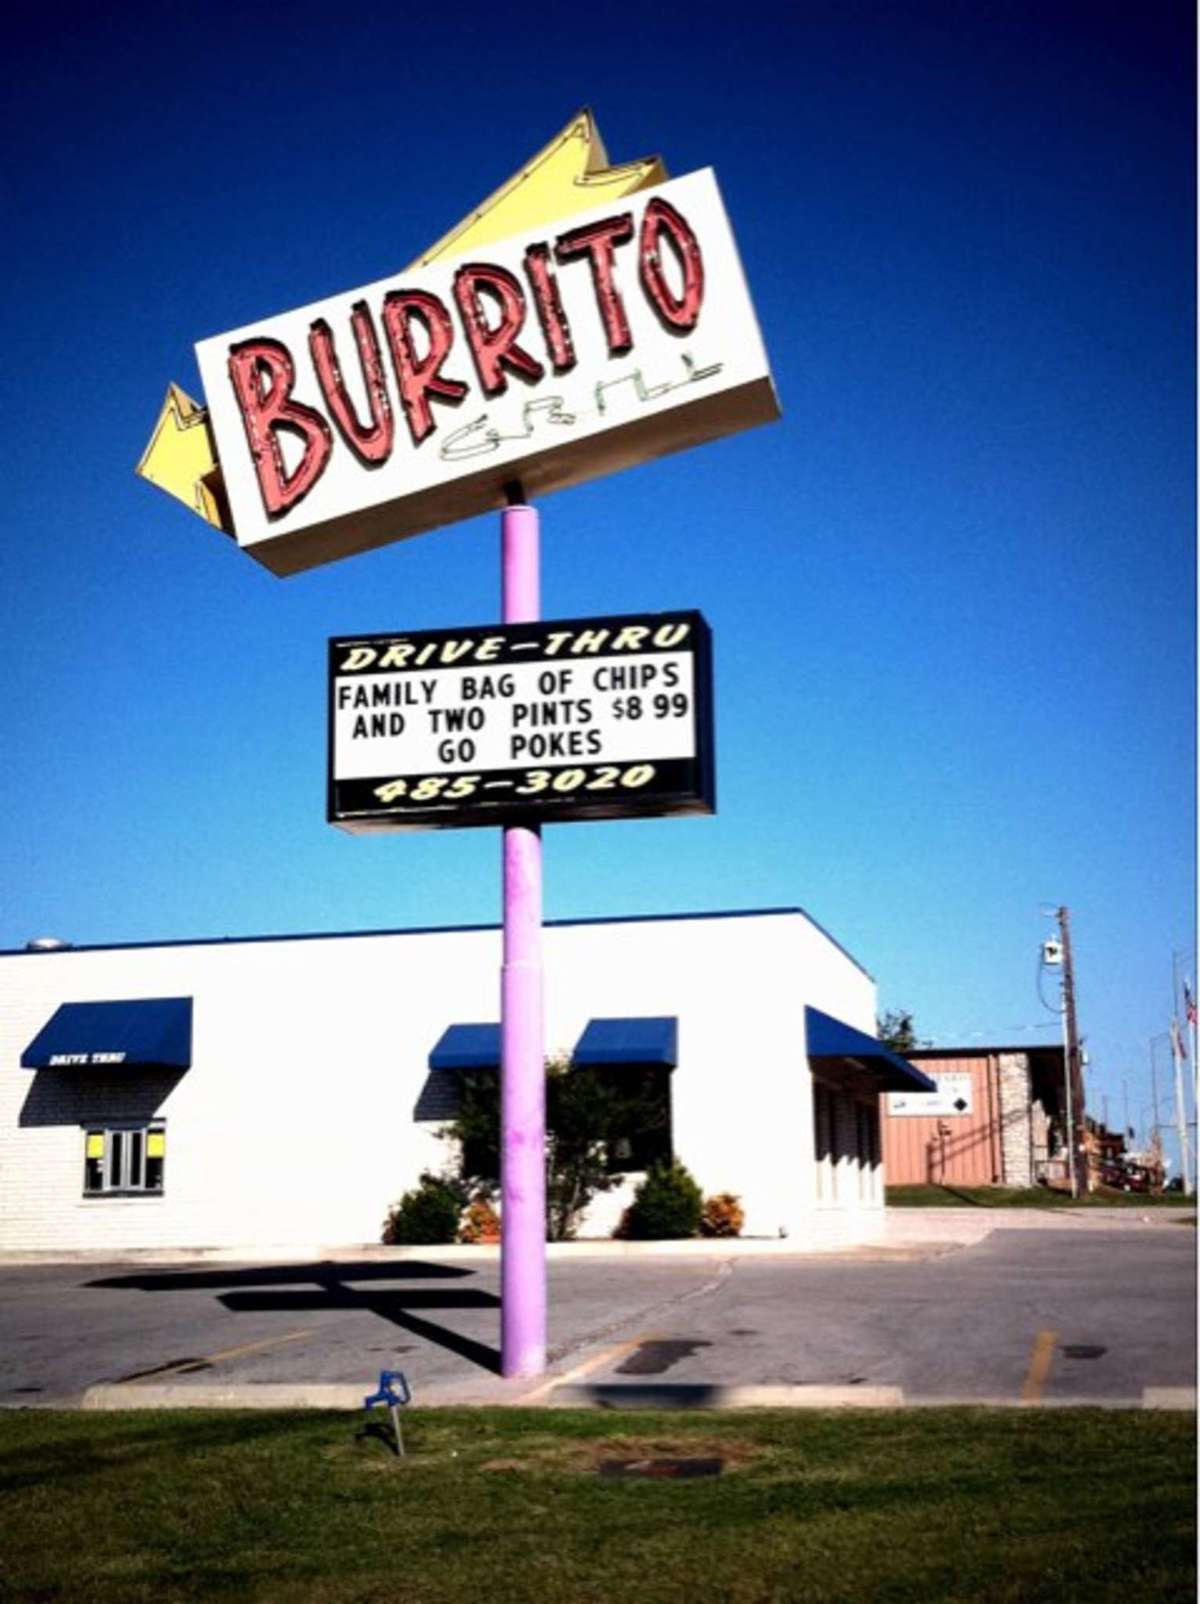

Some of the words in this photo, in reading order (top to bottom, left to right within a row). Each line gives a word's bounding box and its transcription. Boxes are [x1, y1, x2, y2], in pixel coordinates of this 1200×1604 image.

[229, 197, 704, 521] BURRITO
[340, 623, 690, 671] DRIVE-THRU
[338, 679, 437, 710] FAMILY
[461, 673, 515, 701] BAG
[538, 669, 573, 695] OF
[593, 662, 680, 692] CHIPS
[352, 713, 405, 739] AND
[428, 707, 485, 734] TWO
[512, 699, 593, 728] PINTS
[438, 738, 476, 764] GO
[511, 729, 602, 760] POKES
[373, 764, 655, 803] 485-3020
